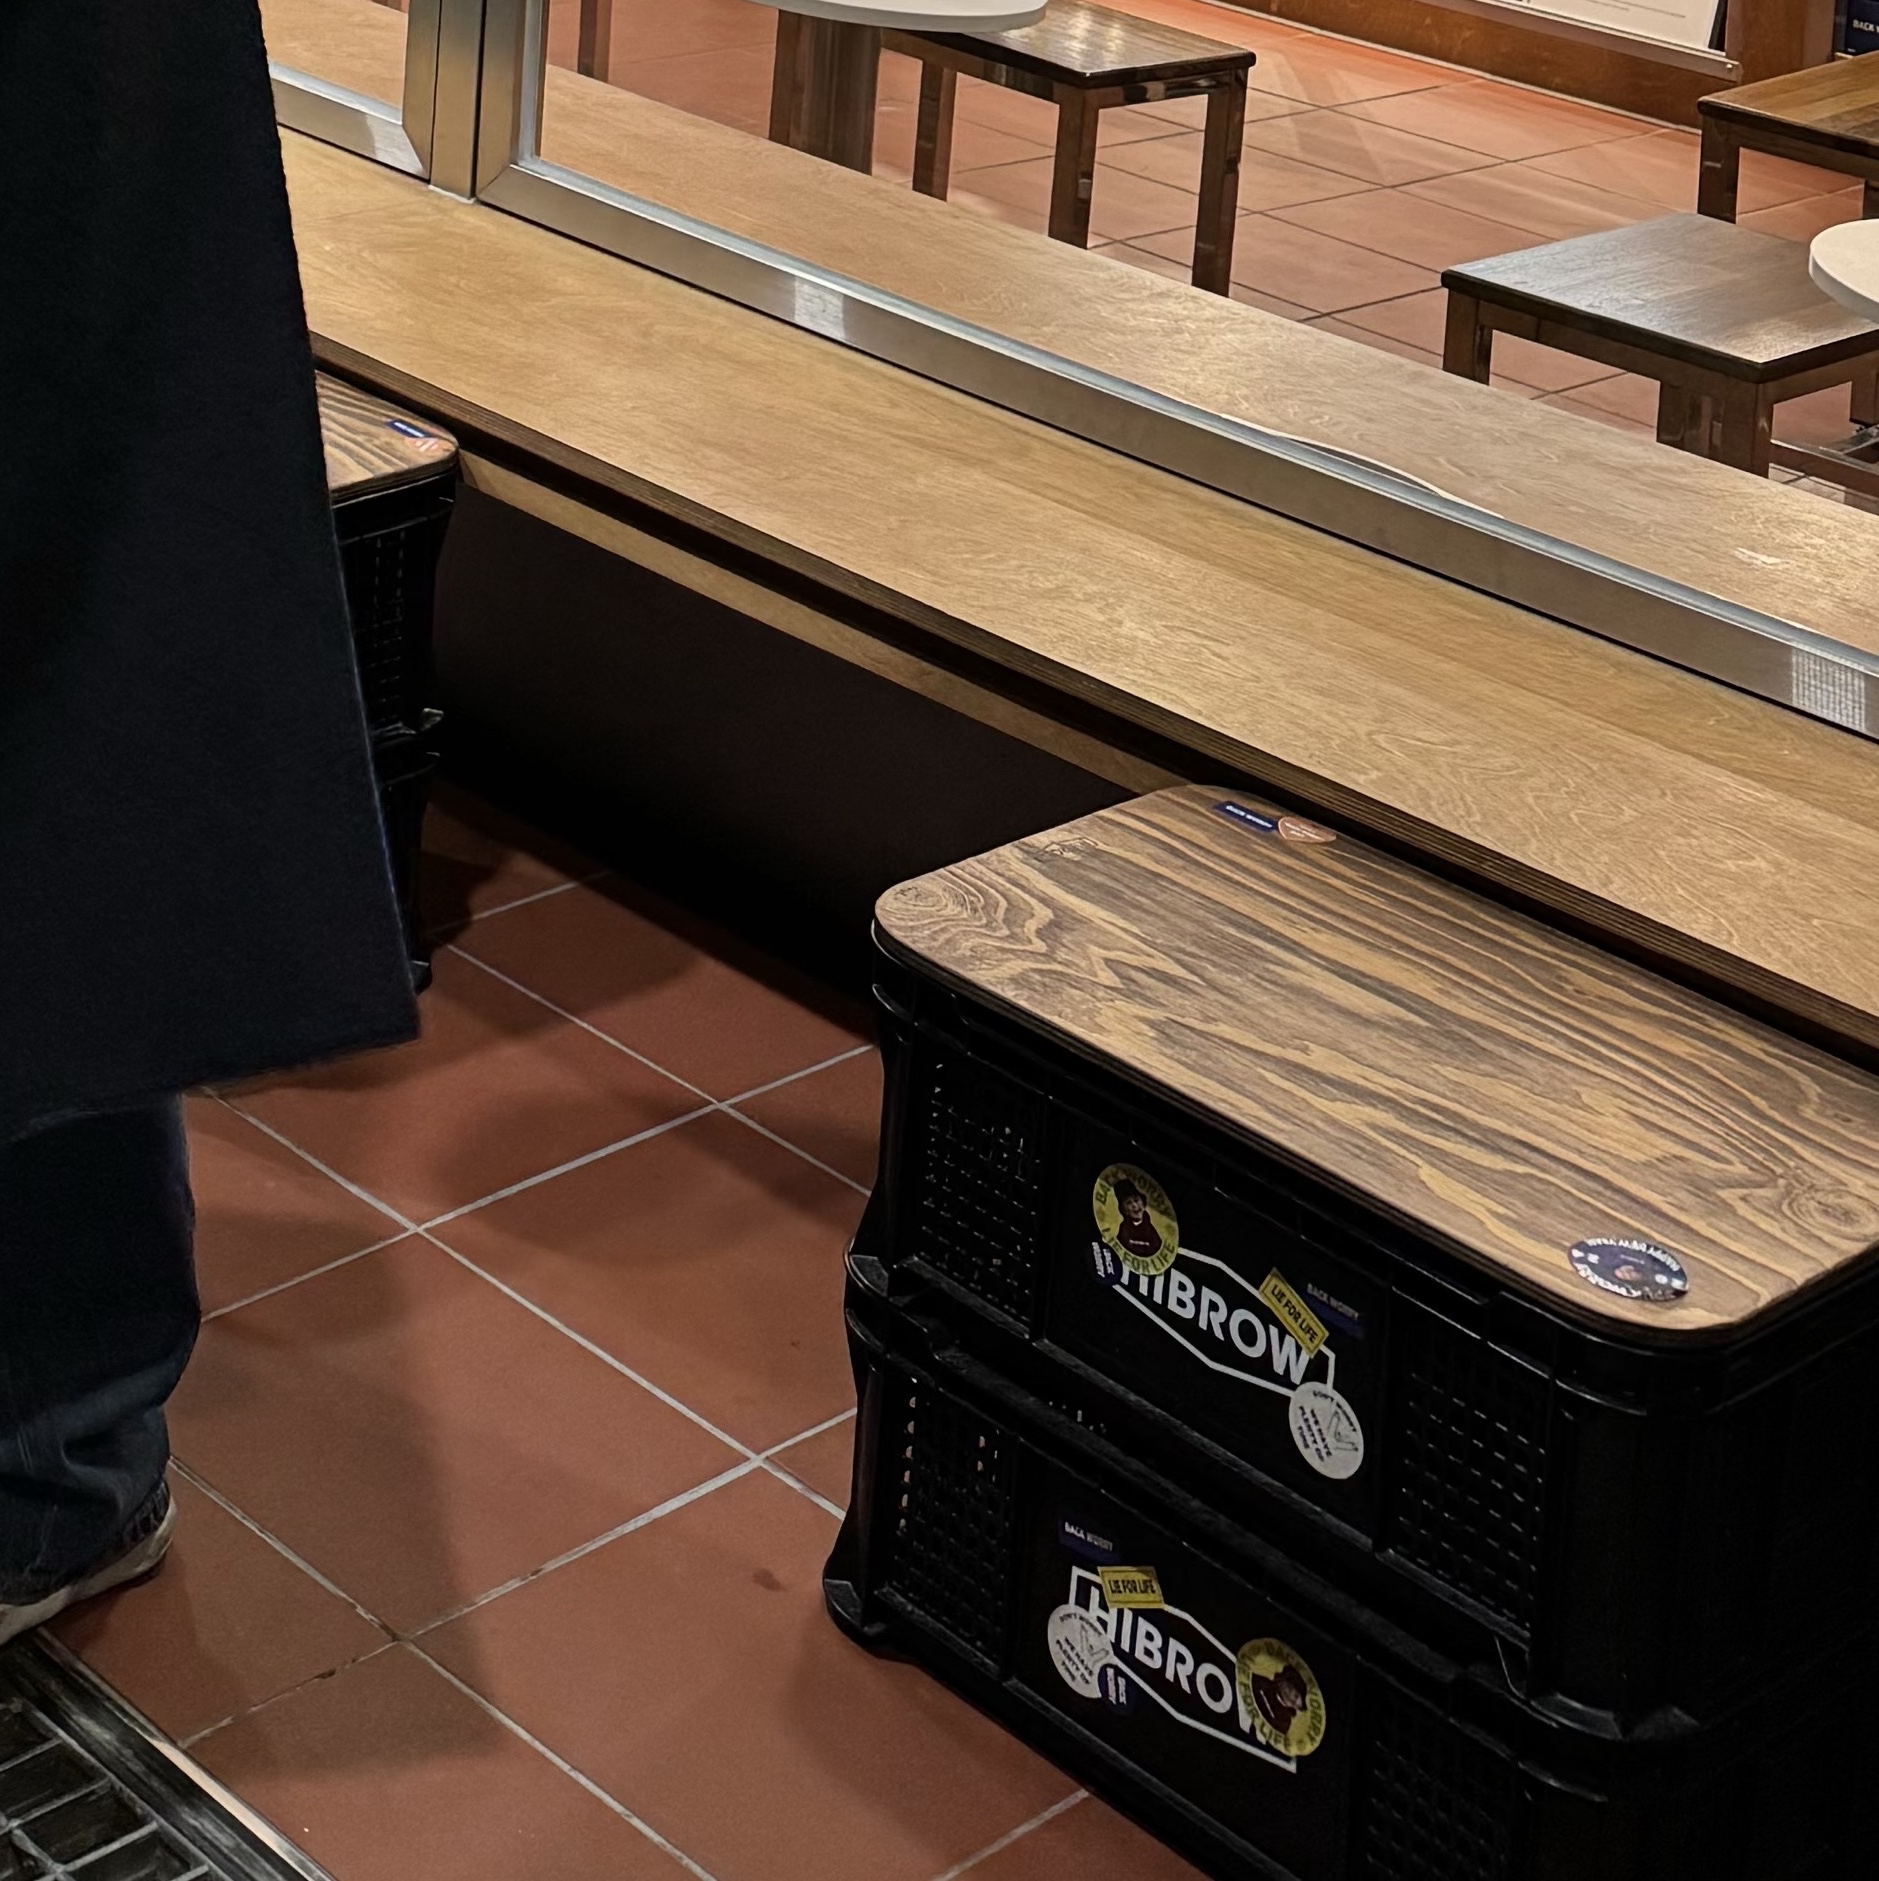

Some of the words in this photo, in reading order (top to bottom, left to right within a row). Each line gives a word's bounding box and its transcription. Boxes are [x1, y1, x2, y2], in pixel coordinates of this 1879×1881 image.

[1270, 1283, 1286, 1304] LIE
[1284, 1299, 1303, 1322] FOR
[1298, 1320, 1319, 1343] LIFE
[1108, 1579, 1122, 1595] LIE
[1138, 1577, 1156, 1594] LIFE
